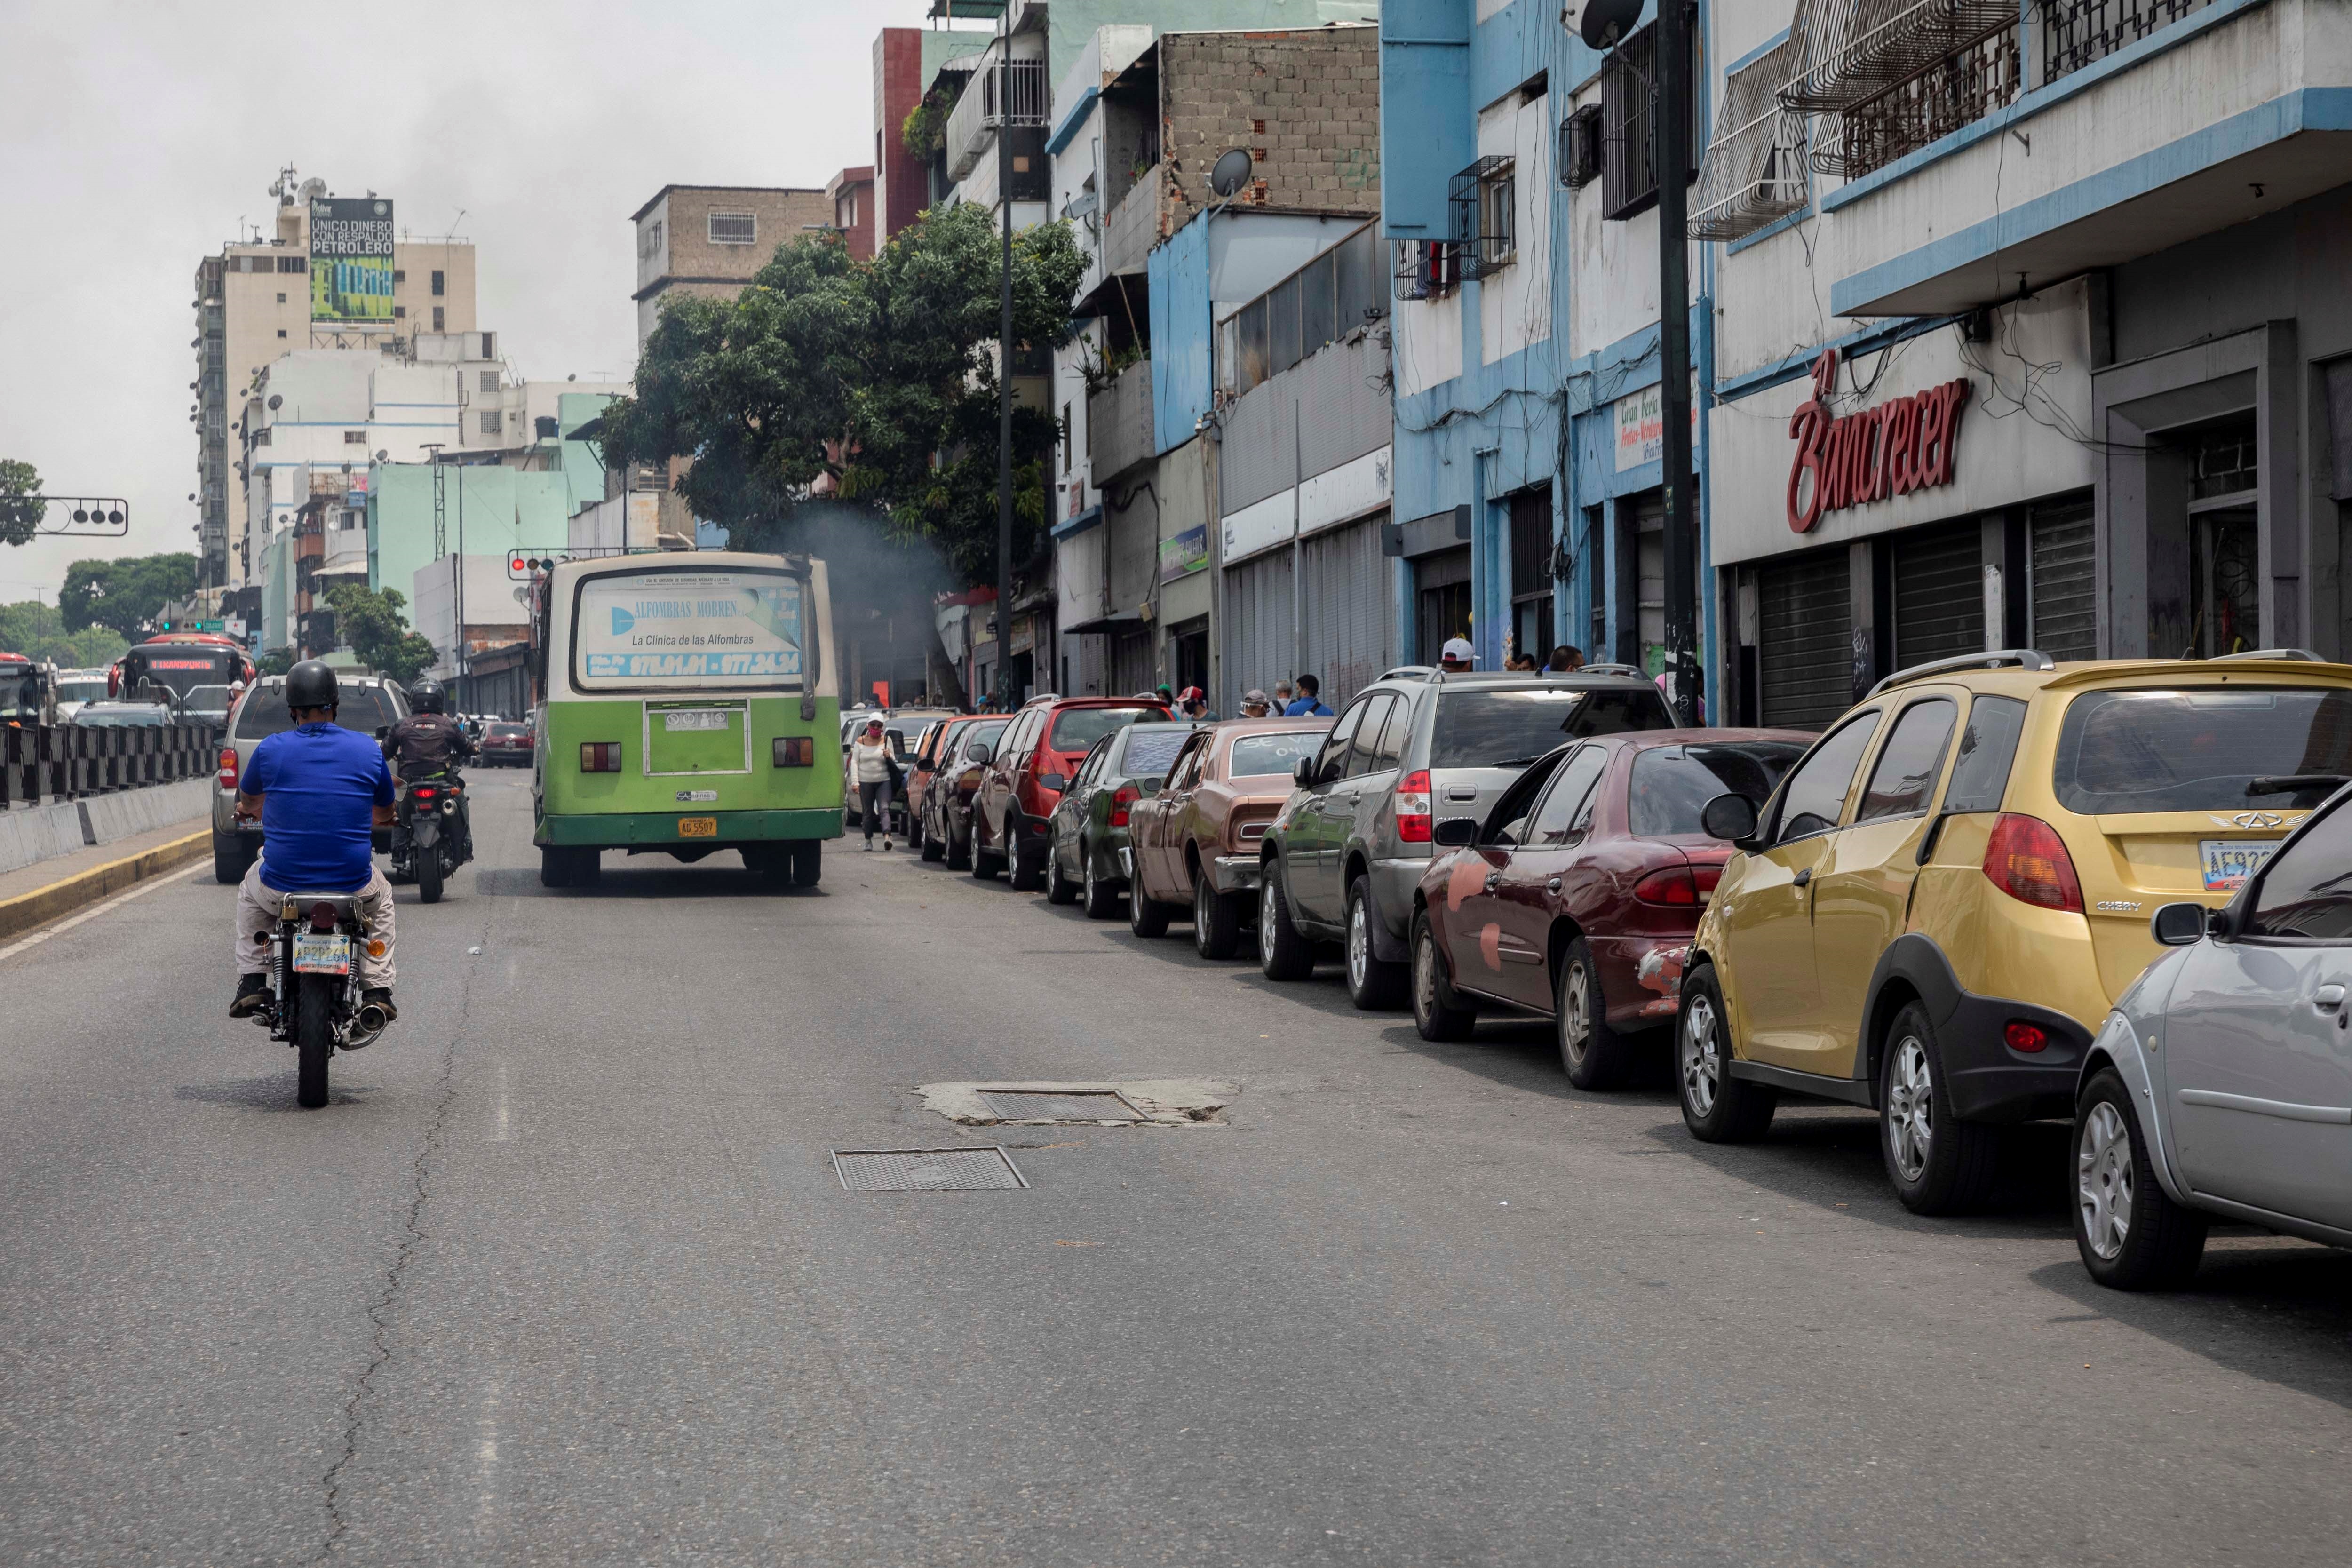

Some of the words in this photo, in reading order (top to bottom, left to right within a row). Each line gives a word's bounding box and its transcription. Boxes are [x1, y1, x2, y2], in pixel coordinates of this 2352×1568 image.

[312, 218, 348, 231] ÚNICO
[351, 221, 392, 232] DINERO
[312, 231, 334, 241] CON
[338, 232, 392, 242] RESPALDO
[313, 242, 392, 254] PETROLERO
[1788, 349, 1968, 533] Bancrecer
[635, 602, 691, 618] ALFOMBRAS
[697, 600, 737, 617] MOBREN
[632, 636, 643, 645] La
[646, 635, 676, 645] Clínica
[679, 635, 689, 645] de
[692, 635, 705, 645] las
[707, 634, 753, 645] Alfombras
[722, 653, 799, 674] 977.24.24
[1242, 737, 1276, 748] SE
[694, 822, 713, 832] 5507
[2097, 901, 2142, 911] CHERY
